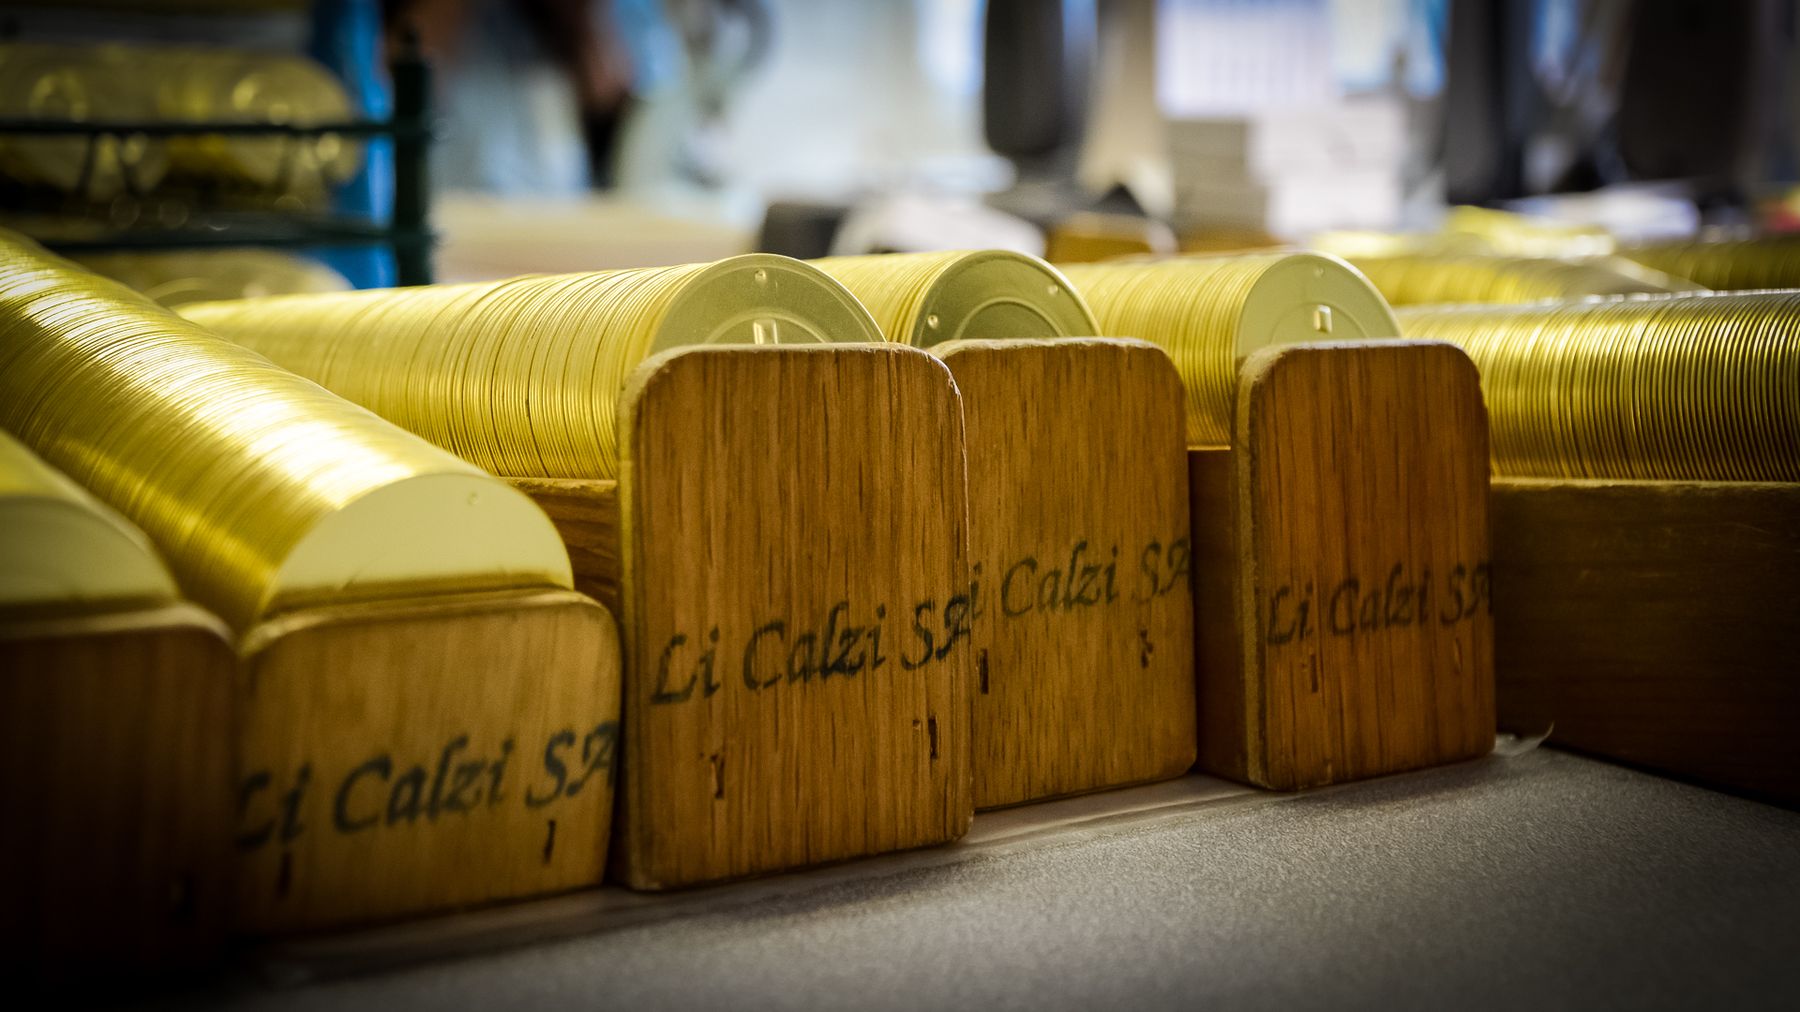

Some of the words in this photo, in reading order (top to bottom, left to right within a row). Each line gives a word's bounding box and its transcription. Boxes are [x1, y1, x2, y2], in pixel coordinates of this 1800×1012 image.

[1001, 540, 1119, 618] Calzi
[1132, 536, 1192, 605] SA
[1265, 582, 1313, 645] Li
[1329, 563, 1431, 637] Calzi
[650, 625, 721, 705] Li
[743, 602, 886, 691] Calzi
[901, 595, 972, 671] SA
[236, 763, 310, 853] Li
[333, 734, 513, 834] Calzi
[525, 720, 619, 808] SA
